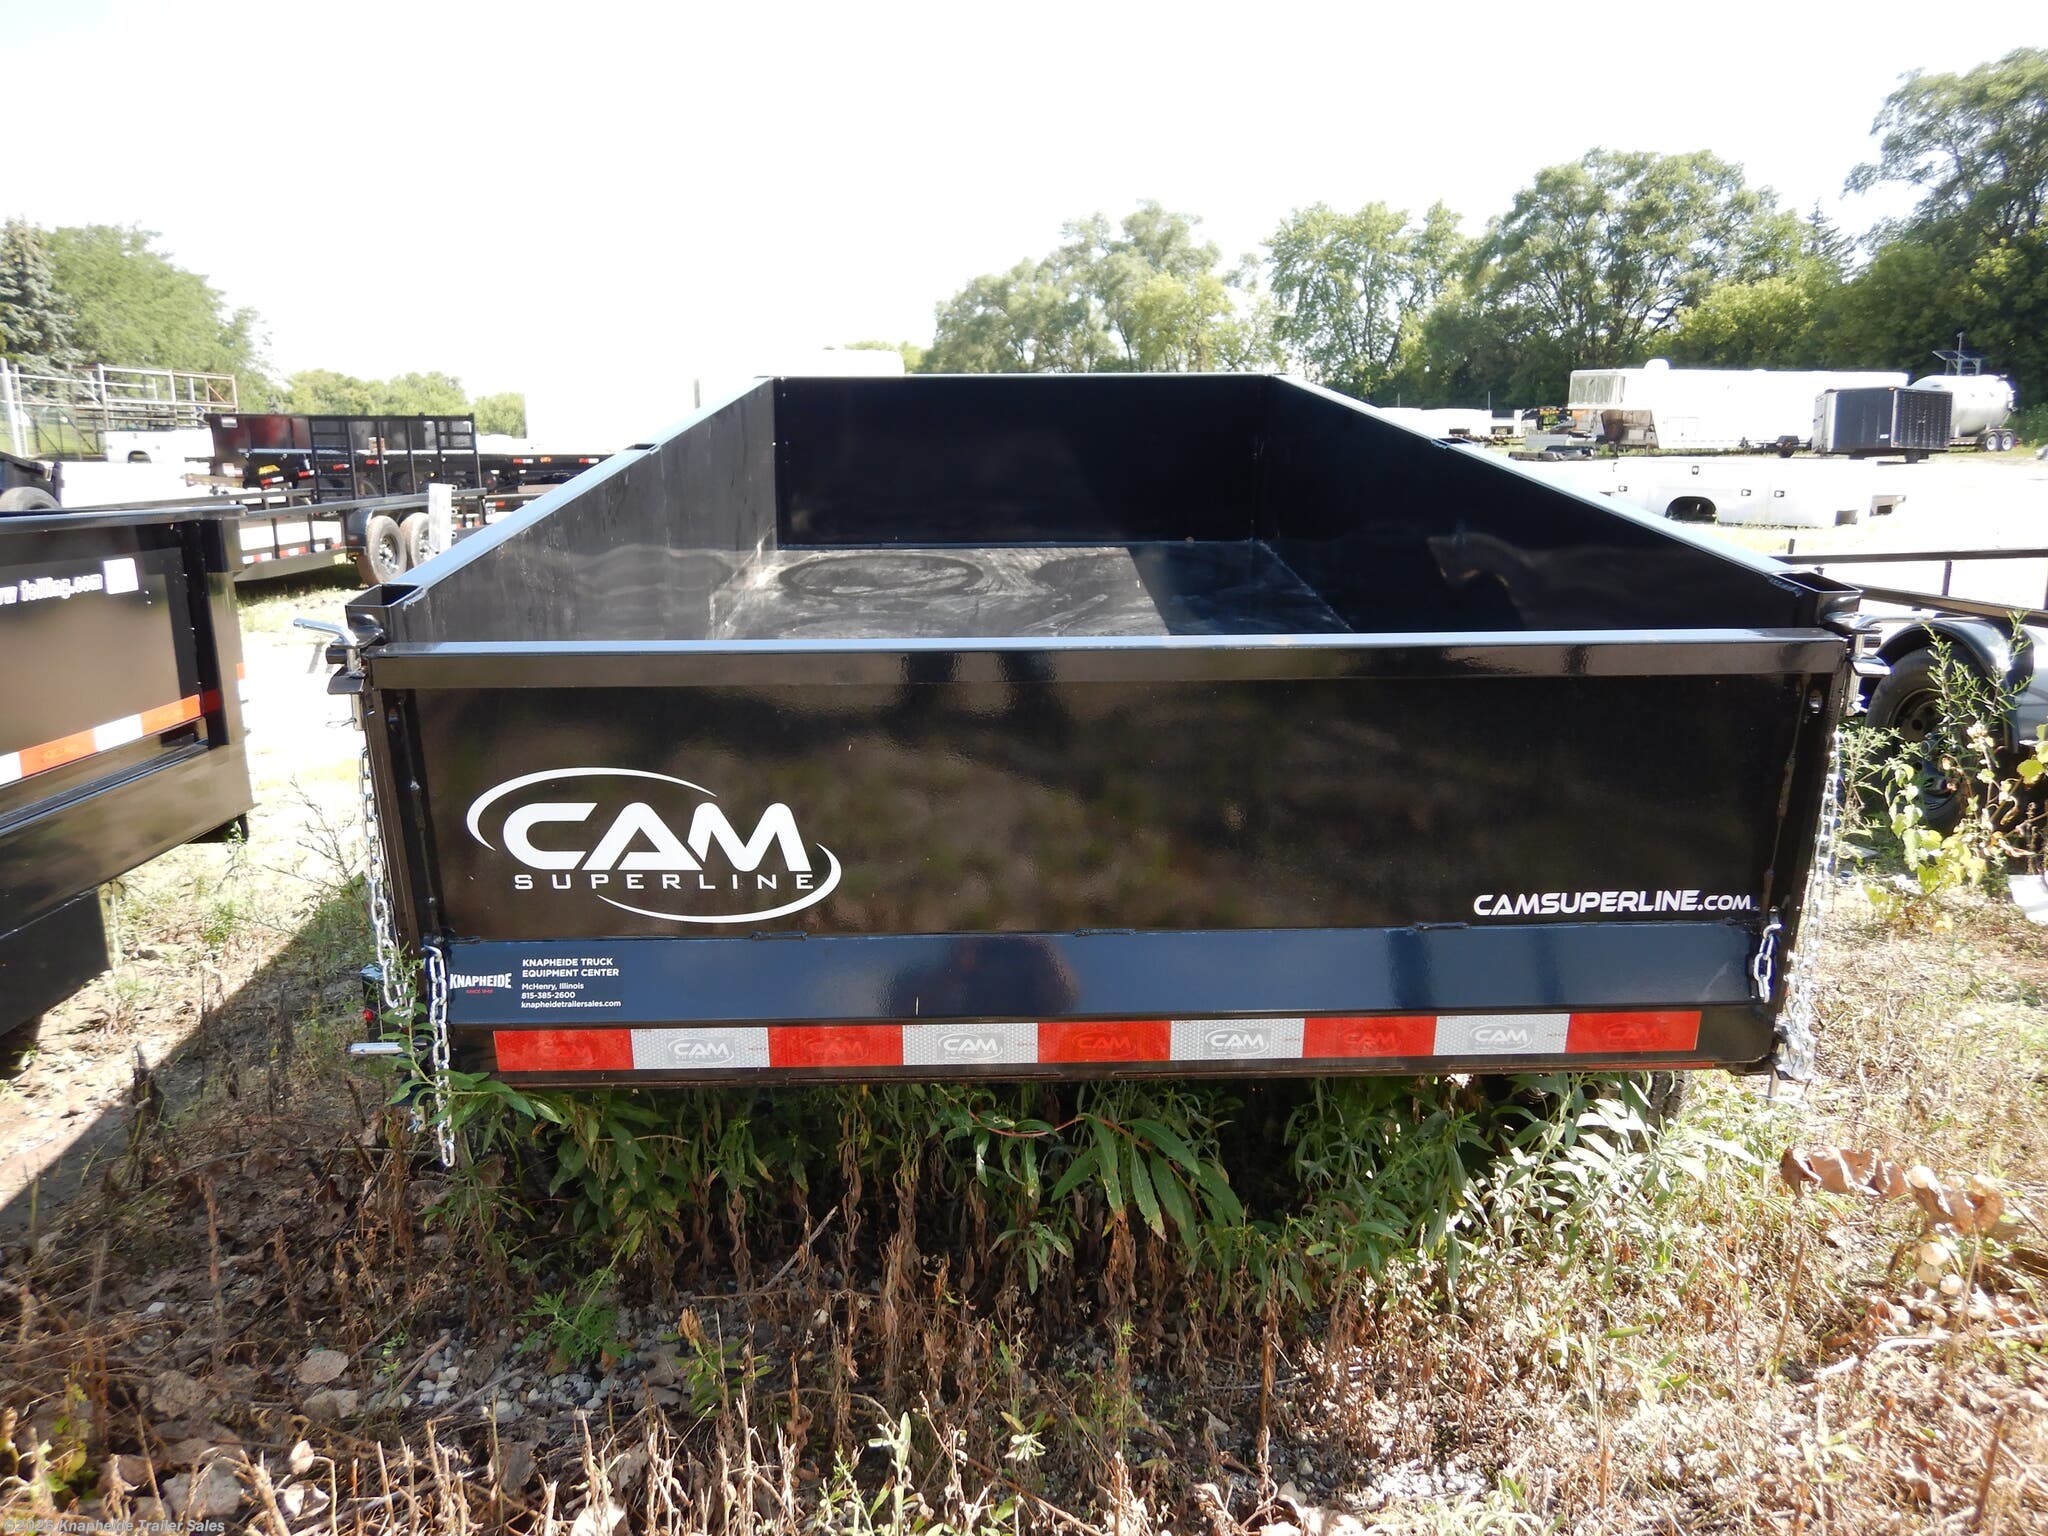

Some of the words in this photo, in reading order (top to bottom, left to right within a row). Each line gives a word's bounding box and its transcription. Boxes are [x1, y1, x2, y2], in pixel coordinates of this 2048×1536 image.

[502, 801, 813, 872] CAM
[514, 873, 814, 890] SUPERLINE
[522, 958, 579, 967] KNAPHEIDE
[580, 957, 613, 966] TRUCK
[522, 969, 579, 978] EQUIPMENT
[580, 968, 620, 977] CENTER
[449, 972, 513, 990] KNAPHEIDE
[521, 982, 558, 991] McHenry,
[559, 982, 585, 990] Illinois
[521, 991, 576, 999] 815-385-2600
[520, 999, 622, 1009] knapheidetrailersales.com
[1210, 1033, 1265, 1047] CAM
[1475, 1029, 1529, 1042] CAM
[674, 1042, 730, 1056] CAM
[943, 1038, 998, 1051] CAM
